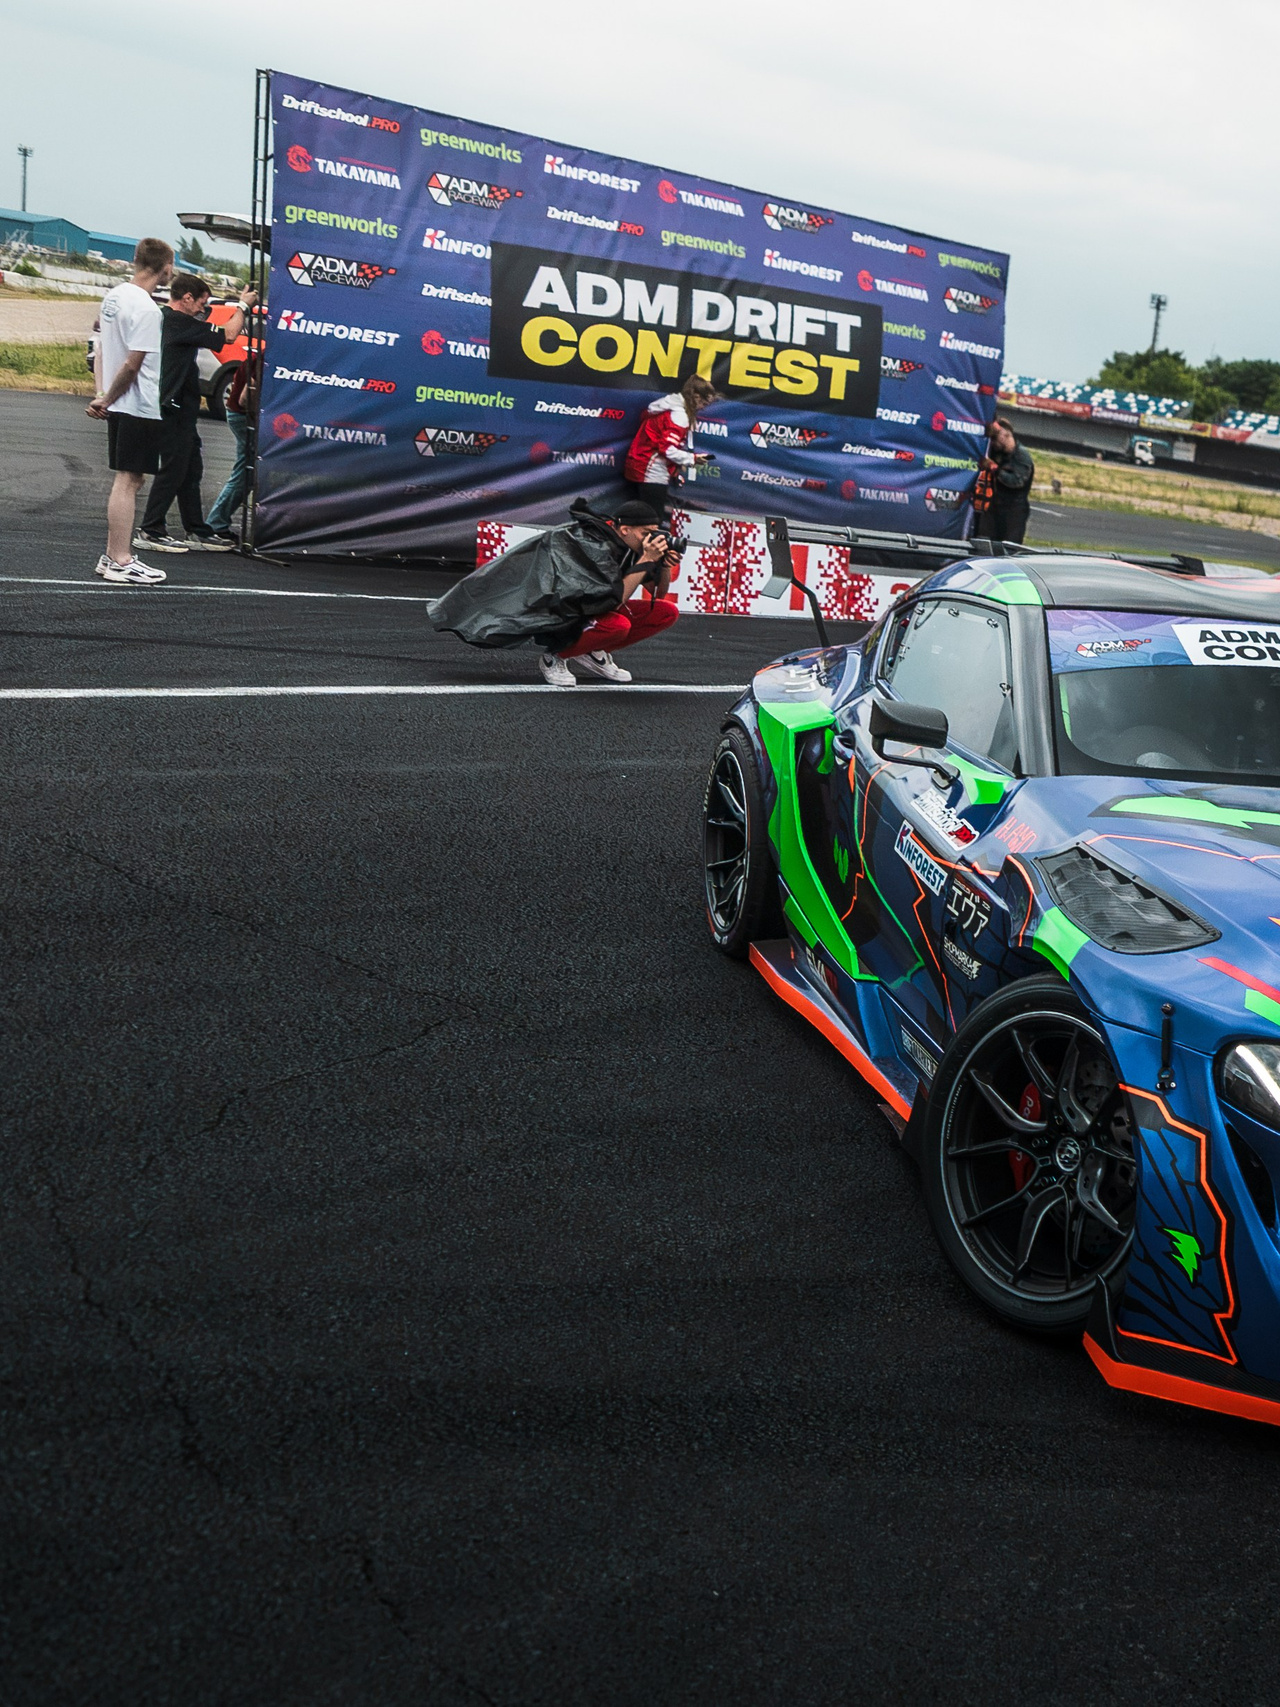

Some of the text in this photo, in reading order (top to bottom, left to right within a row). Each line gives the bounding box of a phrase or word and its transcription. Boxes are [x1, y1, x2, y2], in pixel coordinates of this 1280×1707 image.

[420, 128, 522, 163] greenworks
[315, 158, 401, 189] TAKAYAMA
[544, 155, 641, 193] KINFOREST
[449, 178, 489, 197] ADM
[679, 190, 745, 217] TAKAYAMA
[778, 206, 808, 224] ADM
[285, 204, 399, 239] greenworks
[661, 229, 746, 258] greenworks
[312, 256, 357, 275] ADM
[763, 249, 843, 282] KINFOREST
[938, 252, 1001, 278] greenworks
[311, 269, 373, 289] RACEWAY
[874, 279, 929, 303] TAKAYAMA
[522, 266, 861, 352] ADM DRIFT
[277, 309, 399, 346] KINFOREST
[939, 330, 1001, 359] KINFOREST
[521, 316, 860, 400] CONTEST
[881, 356, 901, 370] DM
[416, 385, 514, 409] greenworks
[876, 407, 921, 425] FOREST
[303, 424, 387, 446] TAKAYAMA
[435, 430, 475, 445] ADM
[766, 424, 800, 439] ADM
[859, 488, 909, 504] TAKAYAMA
[1093, 640, 1124, 649] ADM
[897, 825, 945, 892] KINFOREST
